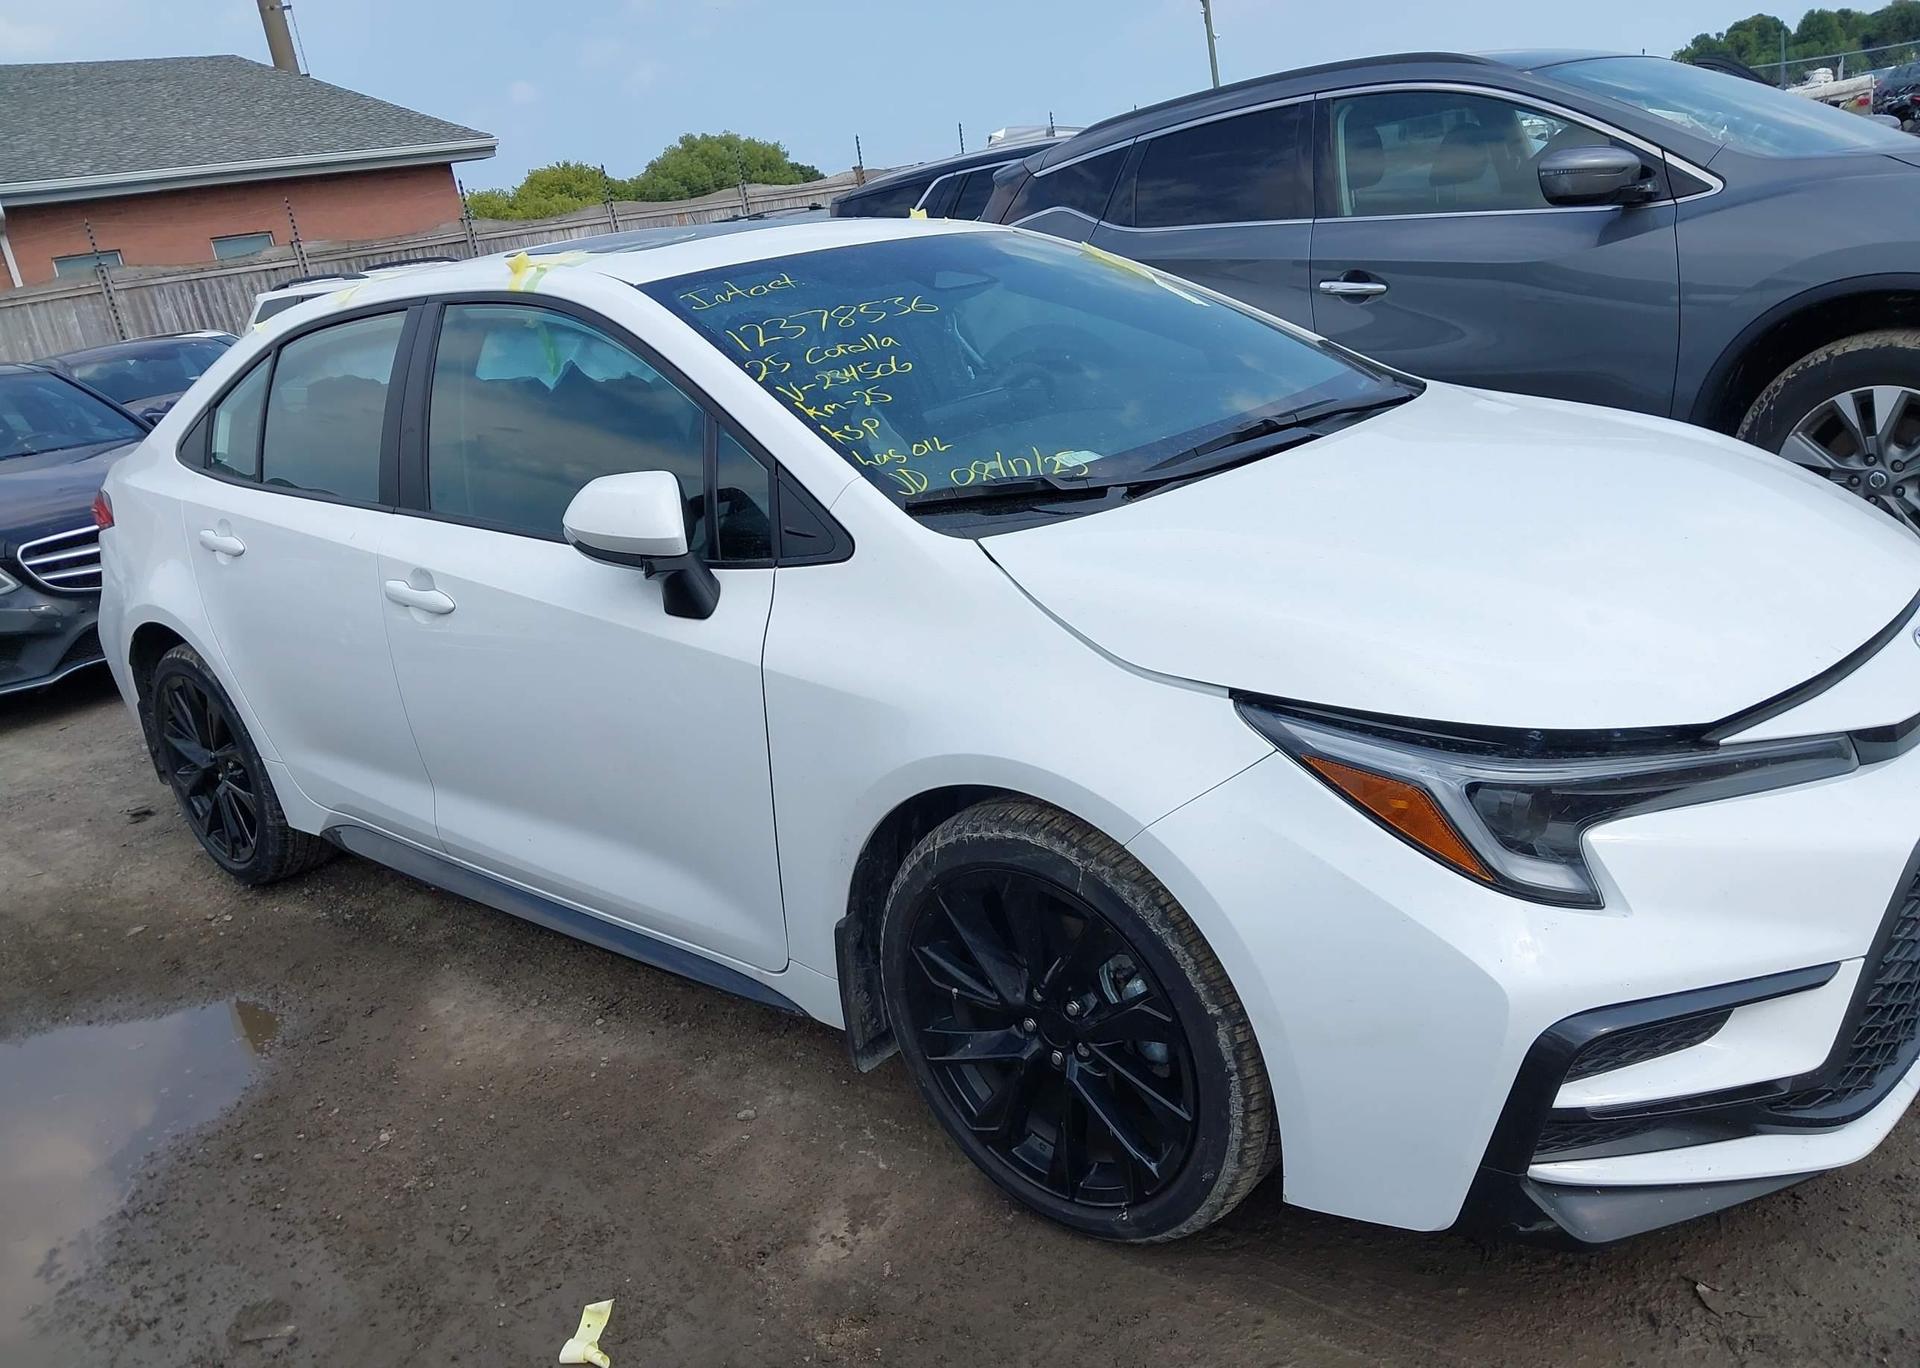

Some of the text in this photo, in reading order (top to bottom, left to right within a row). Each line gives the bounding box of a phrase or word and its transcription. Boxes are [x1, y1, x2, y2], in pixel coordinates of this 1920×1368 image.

[725, 295, 940, 352] 12378536
[744, 333, 902, 382] 25 Corolla
[887, 467, 929, 496] JD
